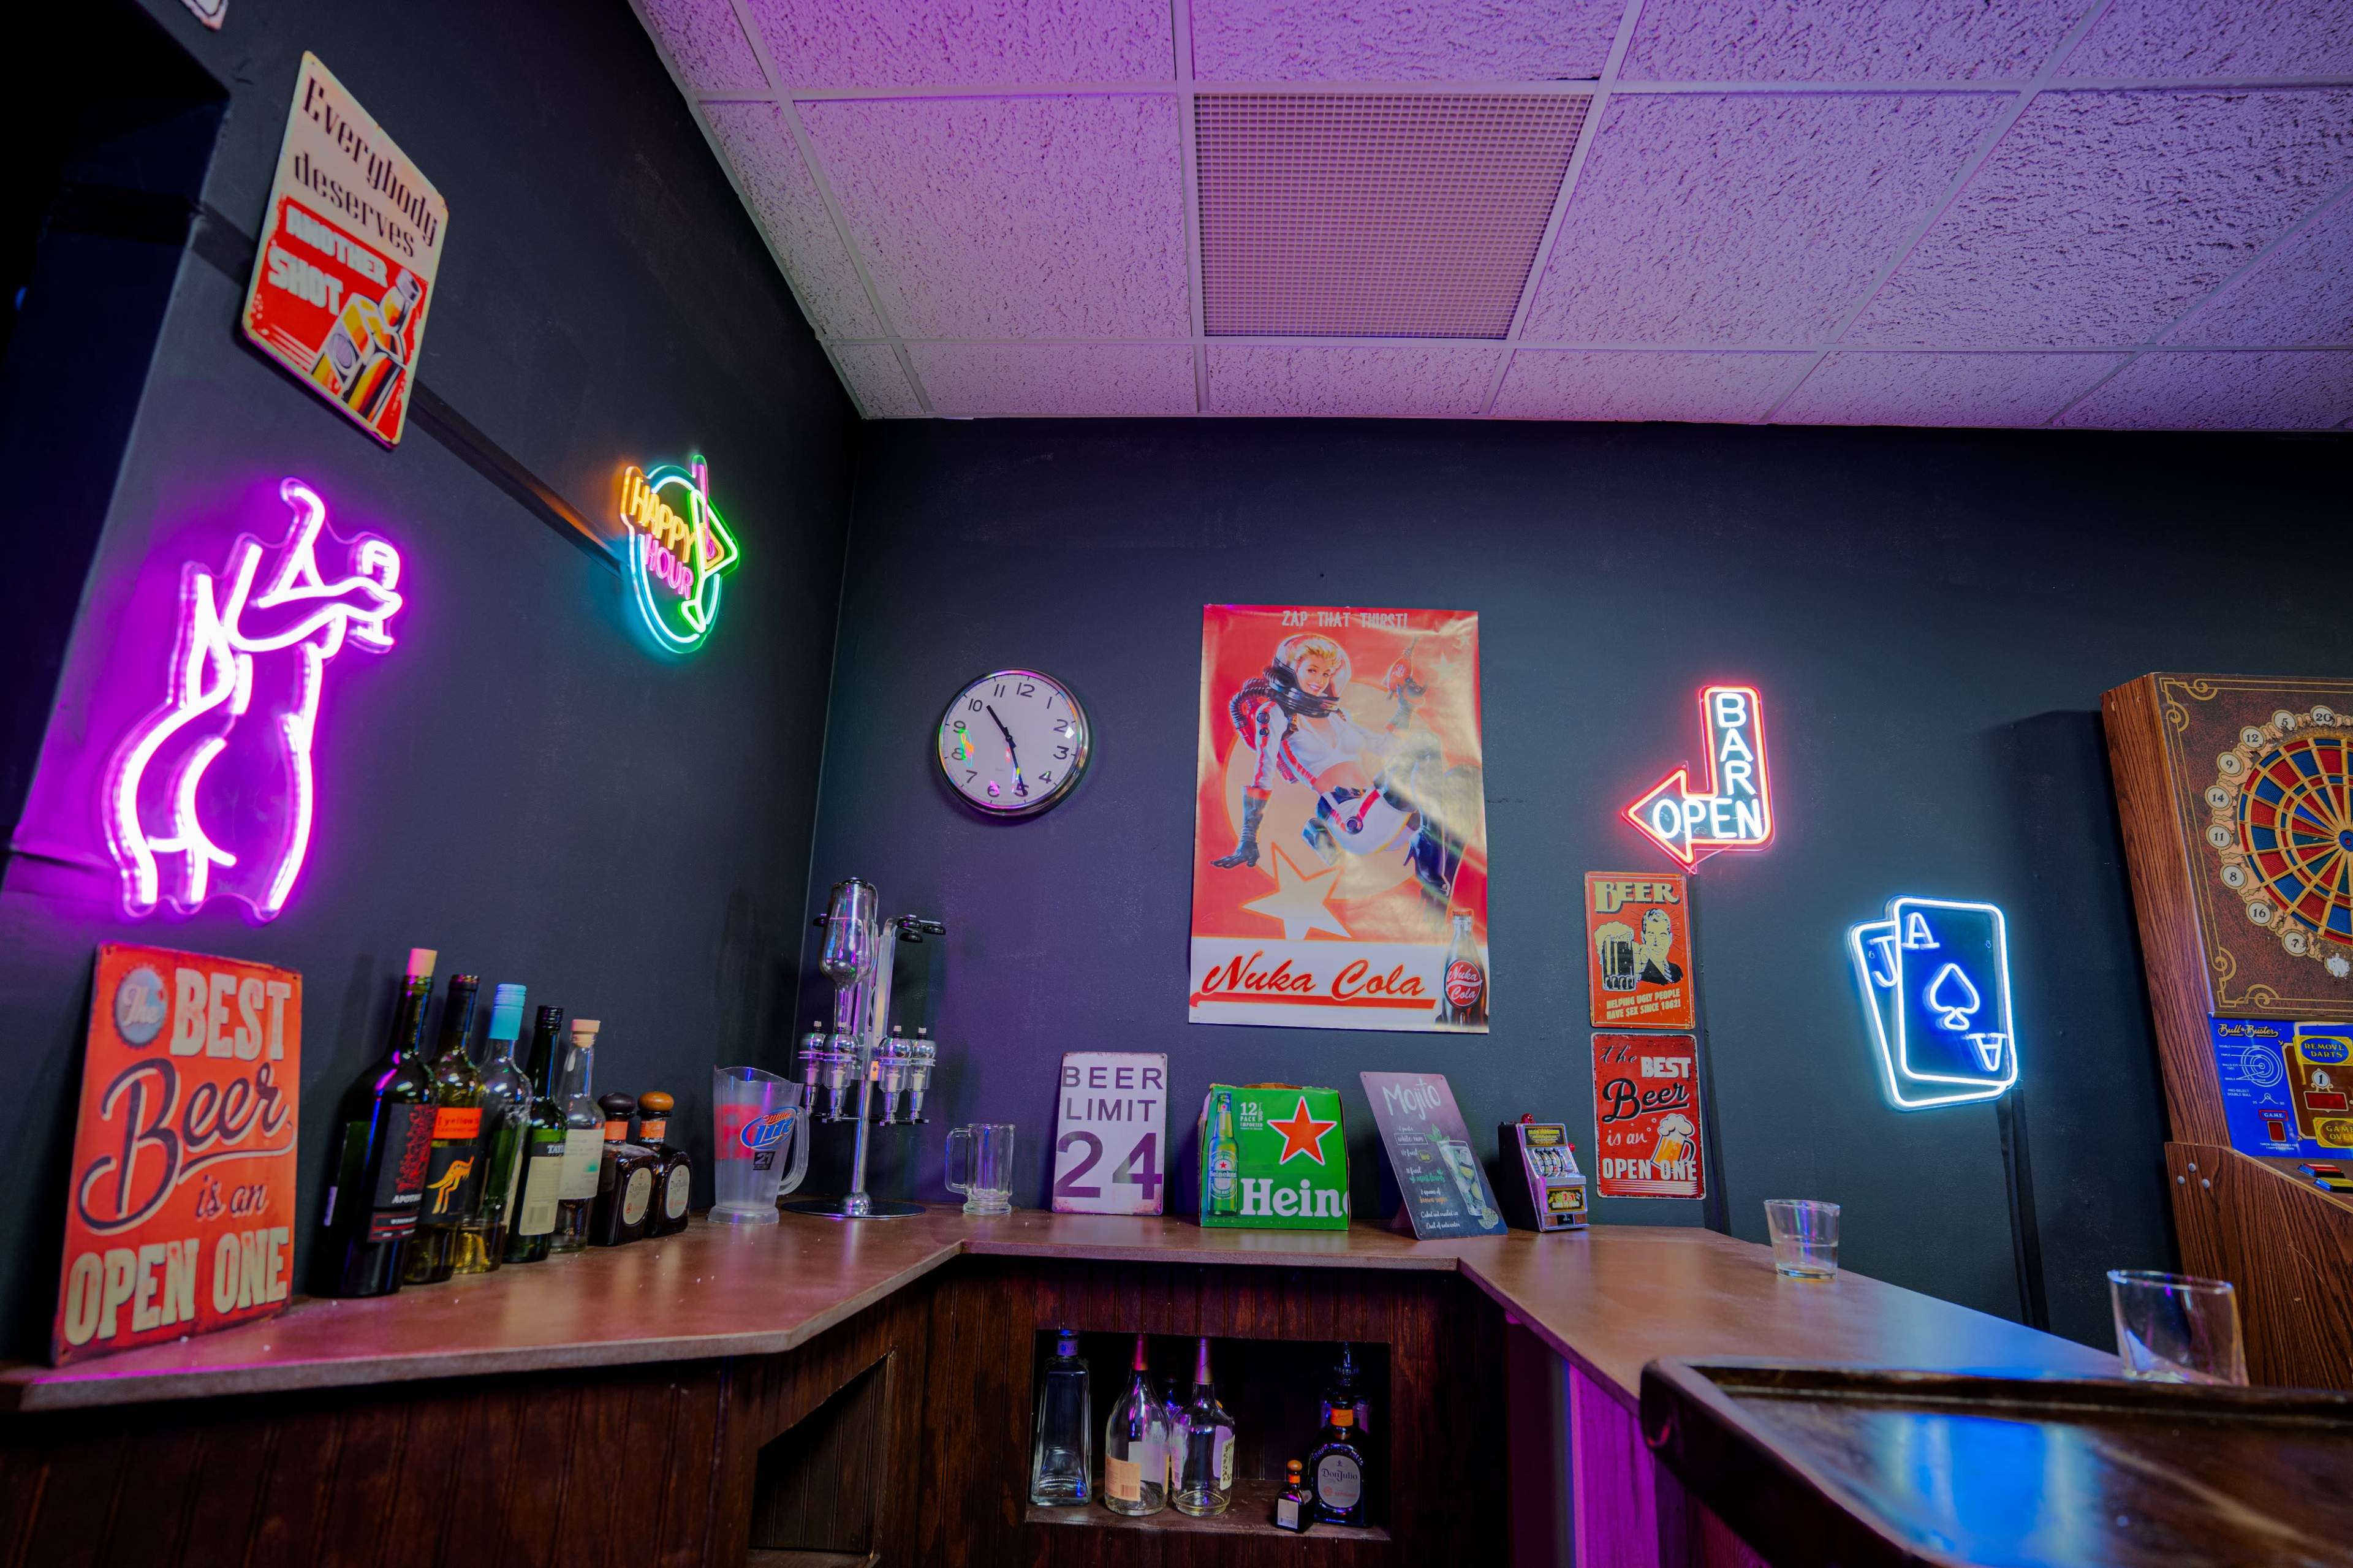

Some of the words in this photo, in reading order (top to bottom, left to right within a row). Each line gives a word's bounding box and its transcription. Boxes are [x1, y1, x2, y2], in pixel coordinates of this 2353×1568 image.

[302, 76, 437, 248] Everybody
[294, 149, 414, 259] deserves
[285, 205, 389, 289] ANOTHER
[268, 246, 343, 316] SHOT
[629, 476, 697, 563] HAPPY
[645, 534, 694, 600] HOUR
[1282, 610, 1308, 627] ZAP
[1317, 612, 1351, 627] THAT
[1360, 612, 1408, 628] THIRST!
[994, 684, 1005, 698] 11
[1017, 682, 1035, 698] 12
[968, 698, 982, 712] 10
[1047, 697, 1052, 710] 1
[953, 720, 966, 733] 9
[1053, 719, 1068, 733] 2
[1715, 692, 1756, 796] BAR
[2246, 734, 2259, 743] 12
[1053, 746, 1069, 760] 3
[2226, 760, 2233, 768] 9
[966, 770, 978, 784] 7
[1039, 771, 1051, 784] 4
[2212, 793, 2224, 802] 14
[1652, 798, 1763, 839] OPEN
[2214, 832, 2224, 841] 11
[2229, 872, 2237, 882] 8
[1593, 881, 1680, 913] BEER
[2253, 908, 2266, 917] 16
[1901, 912, 1940, 949] A
[2292, 939, 2299, 948] 7
[1870, 936, 1898, 987] J
[1203, 950, 1316, 993] Nuka
[1332, 959, 1425, 999] Cola
[1447, 964, 1477, 982] Nuka
[1451, 987, 1476, 1000] Cola
[1607, 996, 1635, 1009] HELPING
[1637, 993, 1653, 1004] UGLY
[1655, 988, 1680, 1001] PEOPLE
[170, 968, 291, 1060] BEST
[1607, 1009, 1624, 1020] HAVE
[1626, 1006, 1639, 1017] SEX
[1640, 1002, 1659, 1014] SINCE
[1963, 1033, 2009, 1072] A
[1062, 1066, 1163, 1089] BEER
[1640, 1056, 1691, 1078] BEST
[2319, 1074, 2323, 1085] 1
[1240, 1102, 1257, 1115] 12
[1382, 1078, 1441, 1120] Mojito
[1602, 1078, 1689, 1123] Beer
[1066, 1098, 1157, 1122] LIMIT
[78, 1058, 295, 1236] Beer
[1607, 1129, 1621, 1146] is
[1626, 1132, 1647, 1146] an
[754, 1152, 775, 1165] 21
[1054, 1131, 1162, 1199] 24
[1602, 1158, 1651, 1180] OPEN
[1660, 1160, 1697, 1181] ONE
[195, 1175, 226, 1217] is
[229, 1183, 268, 1216] an
[1240, 1178, 1349, 1218] Hein
[64, 1238, 199, 1346] OPEN
[213, 1226, 289, 1314] ONE
